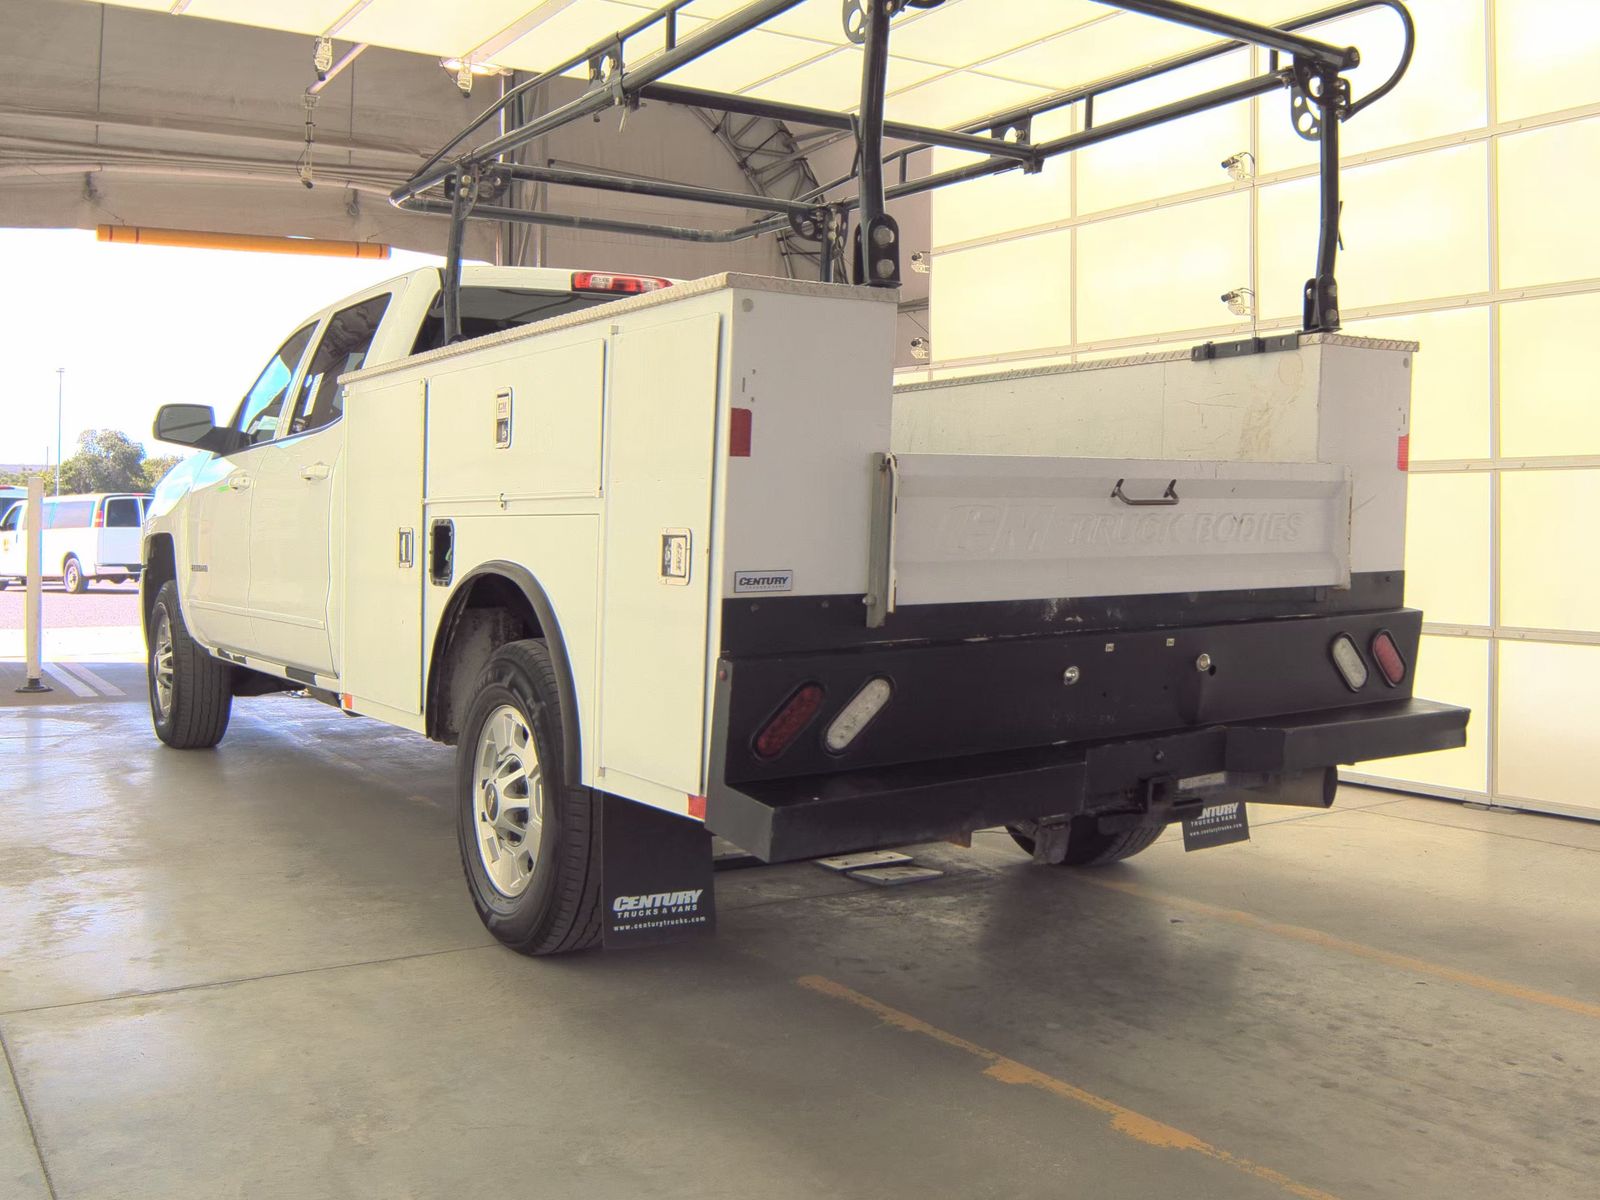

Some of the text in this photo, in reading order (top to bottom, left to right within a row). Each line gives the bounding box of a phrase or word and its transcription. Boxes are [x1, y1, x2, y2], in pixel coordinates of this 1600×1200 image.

[1065, 513, 1186, 545] TRUCK
[1193, 512, 1302, 542] BODIES
[739, 576, 789, 586] CENTURY
[1197, 802, 1239, 819] NTURY
[613, 889, 704, 912] CENTURY
[617, 908, 659, 919] TRUCKS
[671, 904, 698, 913] VANS
[613, 915, 706, 931] www.centurytrucks.com
